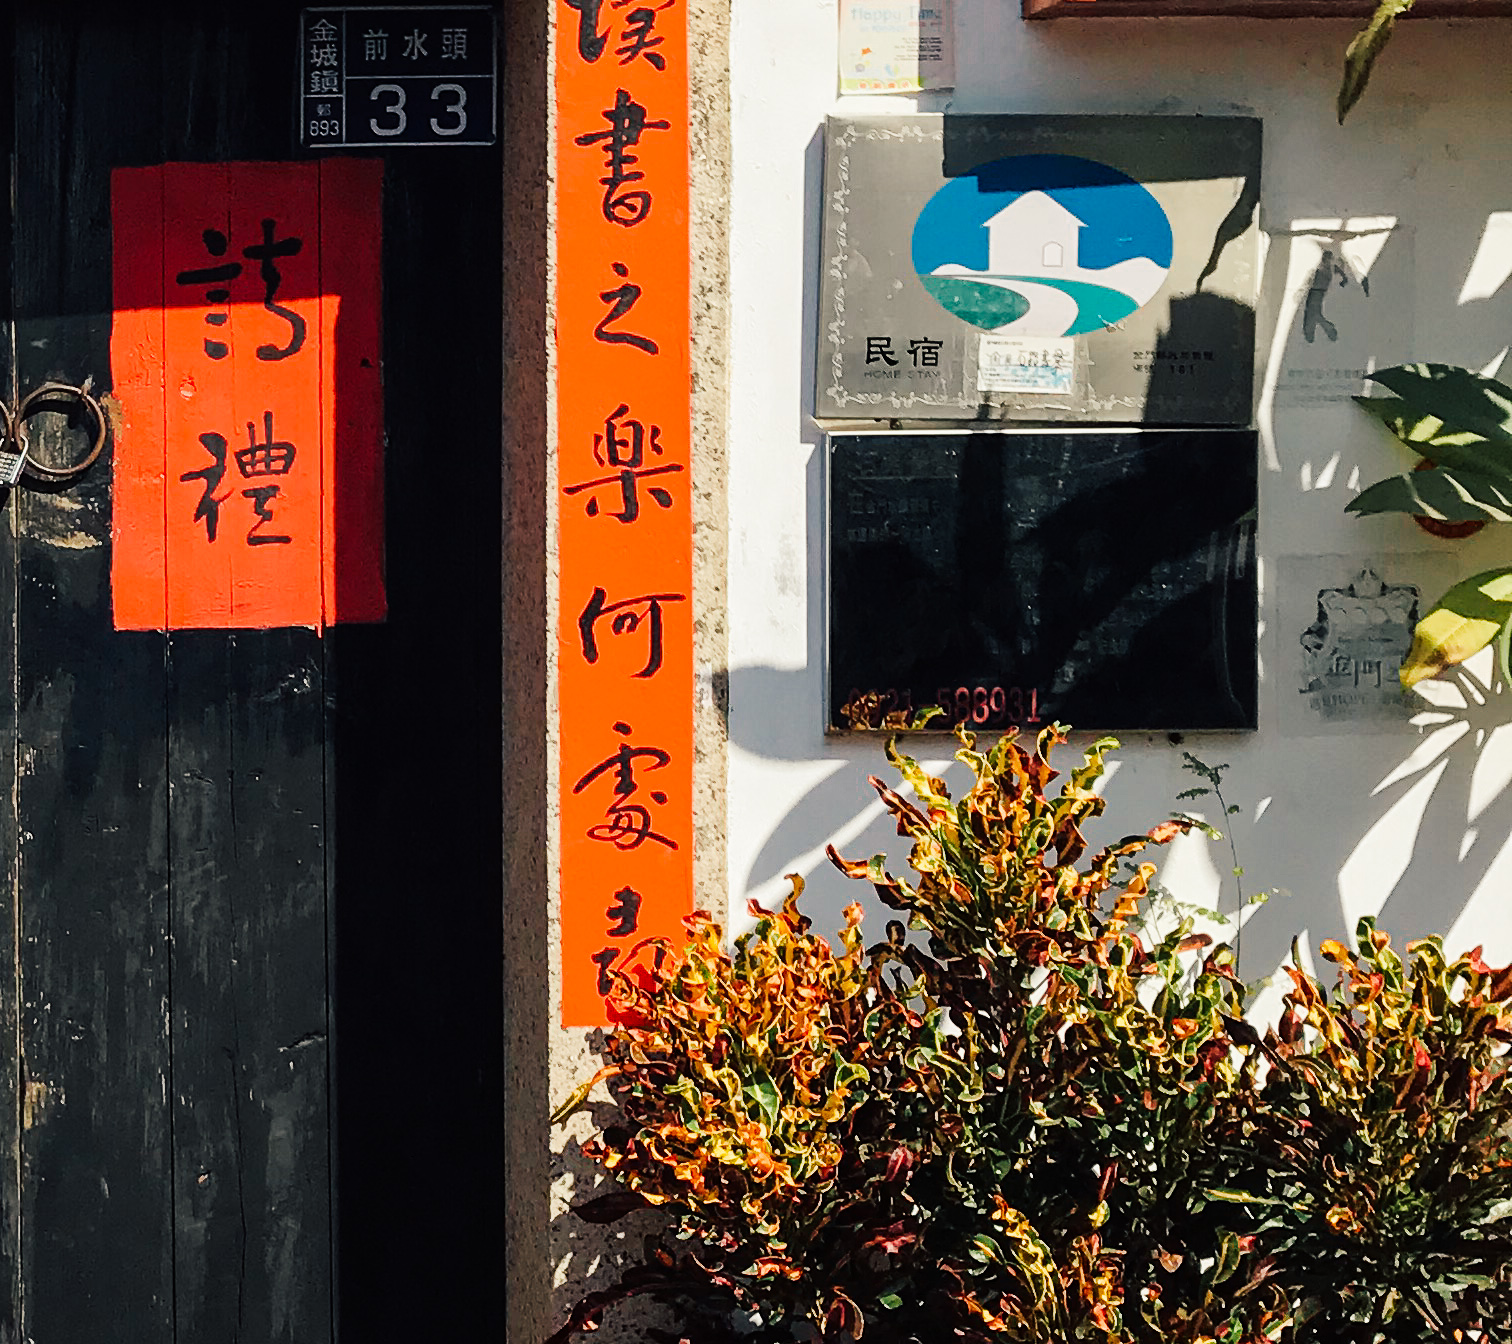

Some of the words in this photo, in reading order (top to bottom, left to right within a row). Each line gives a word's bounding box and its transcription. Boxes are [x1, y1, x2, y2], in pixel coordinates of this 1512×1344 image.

[309, 19, 339, 93] 金城鎮
[362, 28, 468, 61] 前水頭
[369, 83, 468, 136] 33
[309, 120, 340, 137] 893
[864, 336, 944, 367] 民宿
[176, 219, 307, 548] 詩禮
[864, 370, 900, 379] HOME
